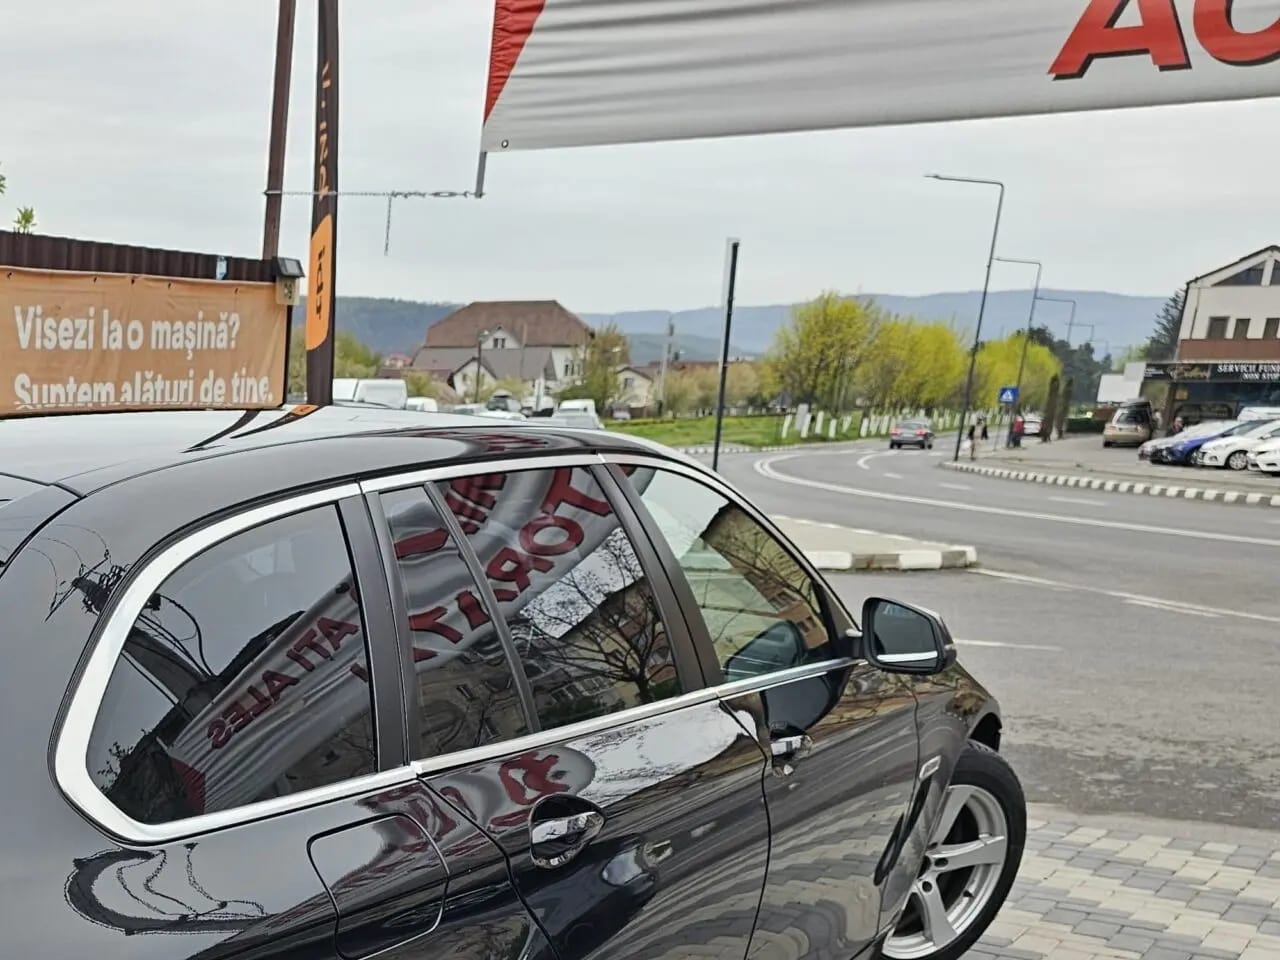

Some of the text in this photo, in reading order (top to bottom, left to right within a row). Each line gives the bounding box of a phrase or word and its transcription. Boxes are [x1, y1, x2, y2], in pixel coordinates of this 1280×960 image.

[14, 305, 95, 350] Visezi
[102, 308, 123, 350] la
[127, 319, 144, 350] o
[14, 372, 116, 407] Suntem
[200, 369, 227, 405] de
[231, 367, 274, 403] tine.
[1258, 363, 1280, 374] FUN
